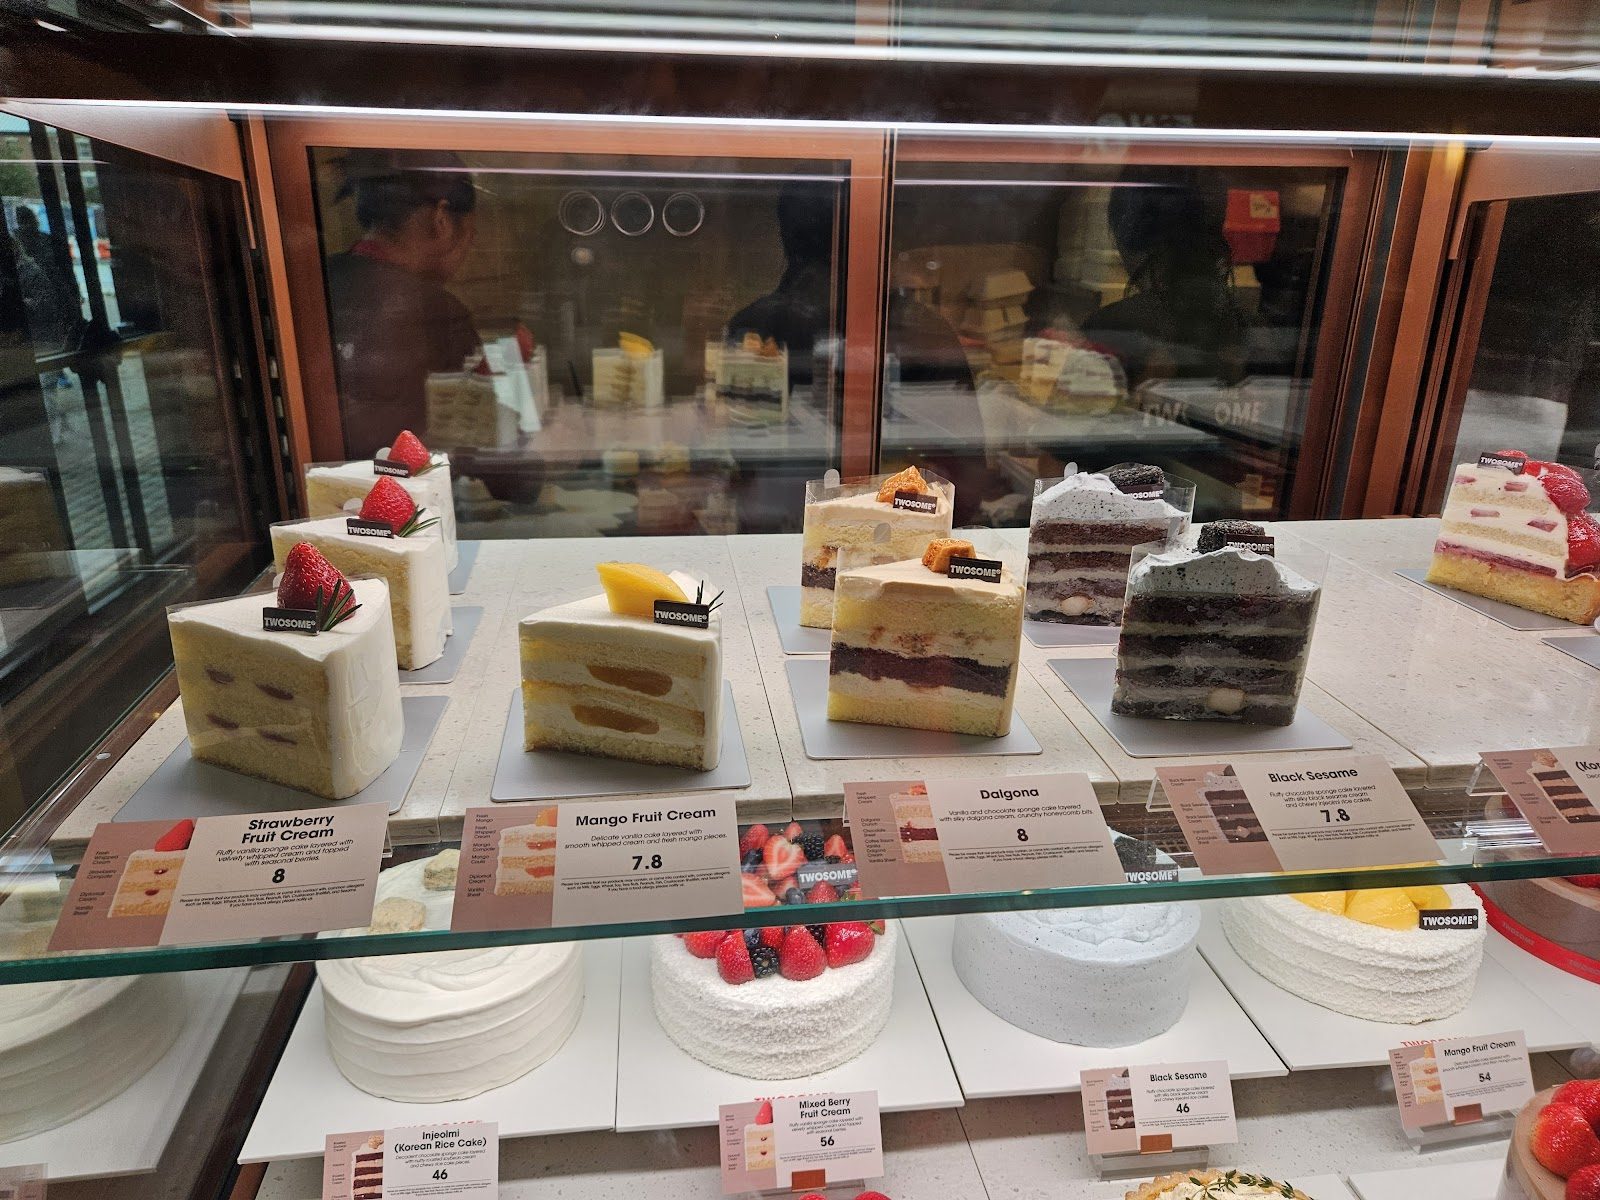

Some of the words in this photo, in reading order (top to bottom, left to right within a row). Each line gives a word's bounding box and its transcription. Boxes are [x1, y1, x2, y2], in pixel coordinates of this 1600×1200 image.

[1268, 772, 1305, 782] Black
[1306, 769, 1358, 780] Sesame
[980, 789, 1039, 801] Dalgona
[576, 816, 627, 827] Mango
[633, 811, 662, 823] Fruit
[667, 809, 716, 821] Cream
[1320, 808, 1350, 823] 7.8
[248, 815, 334, 830] Strawberry
[242, 831, 276, 844] Fruit
[280, 828, 334, 841] Cream
[1017, 828, 1029, 842] 8
[310, 841, 338, 850] layered
[339, 839, 354, 848] with
[591, 839, 621, 847] whipped
[218, 854, 246, 862] velvety
[246, 850, 281, 860] whipped
[280, 849, 304, 857] cream
[305, 847, 321, 855] and
[322, 846, 349, 854] topped
[261, 857, 294, 865] seasonal
[632, 854, 662, 870] 7.8
[272, 868, 285, 884] 8
[1444, 1047, 1471, 1056] Mango
[1472, 1044, 1488, 1052] Fruit
[1490, 1041, 1516, 1050] Cream
[1150, 1073, 1173, 1082] Black
[1174, 1072, 1207, 1080] Sesame
[1479, 1072, 1491, 1082] 54
[799, 1099, 826, 1109] Mixed
[828, 1098, 850, 1106] Berry
[1176, 1103, 1190, 1113] 46
[800, 1110, 818, 1119] Fruit
[821, 1108, 851, 1117] Cream
[422, 1129, 459, 1141] Injeolmi
[394, 1143, 432, 1153] (Korean
[435, 1141, 455, 1149] Rice
[457, 1137, 487, 1147] Cake)
[820, 1136, 835, 1147] 56
[432, 1169, 448, 1180] 46
